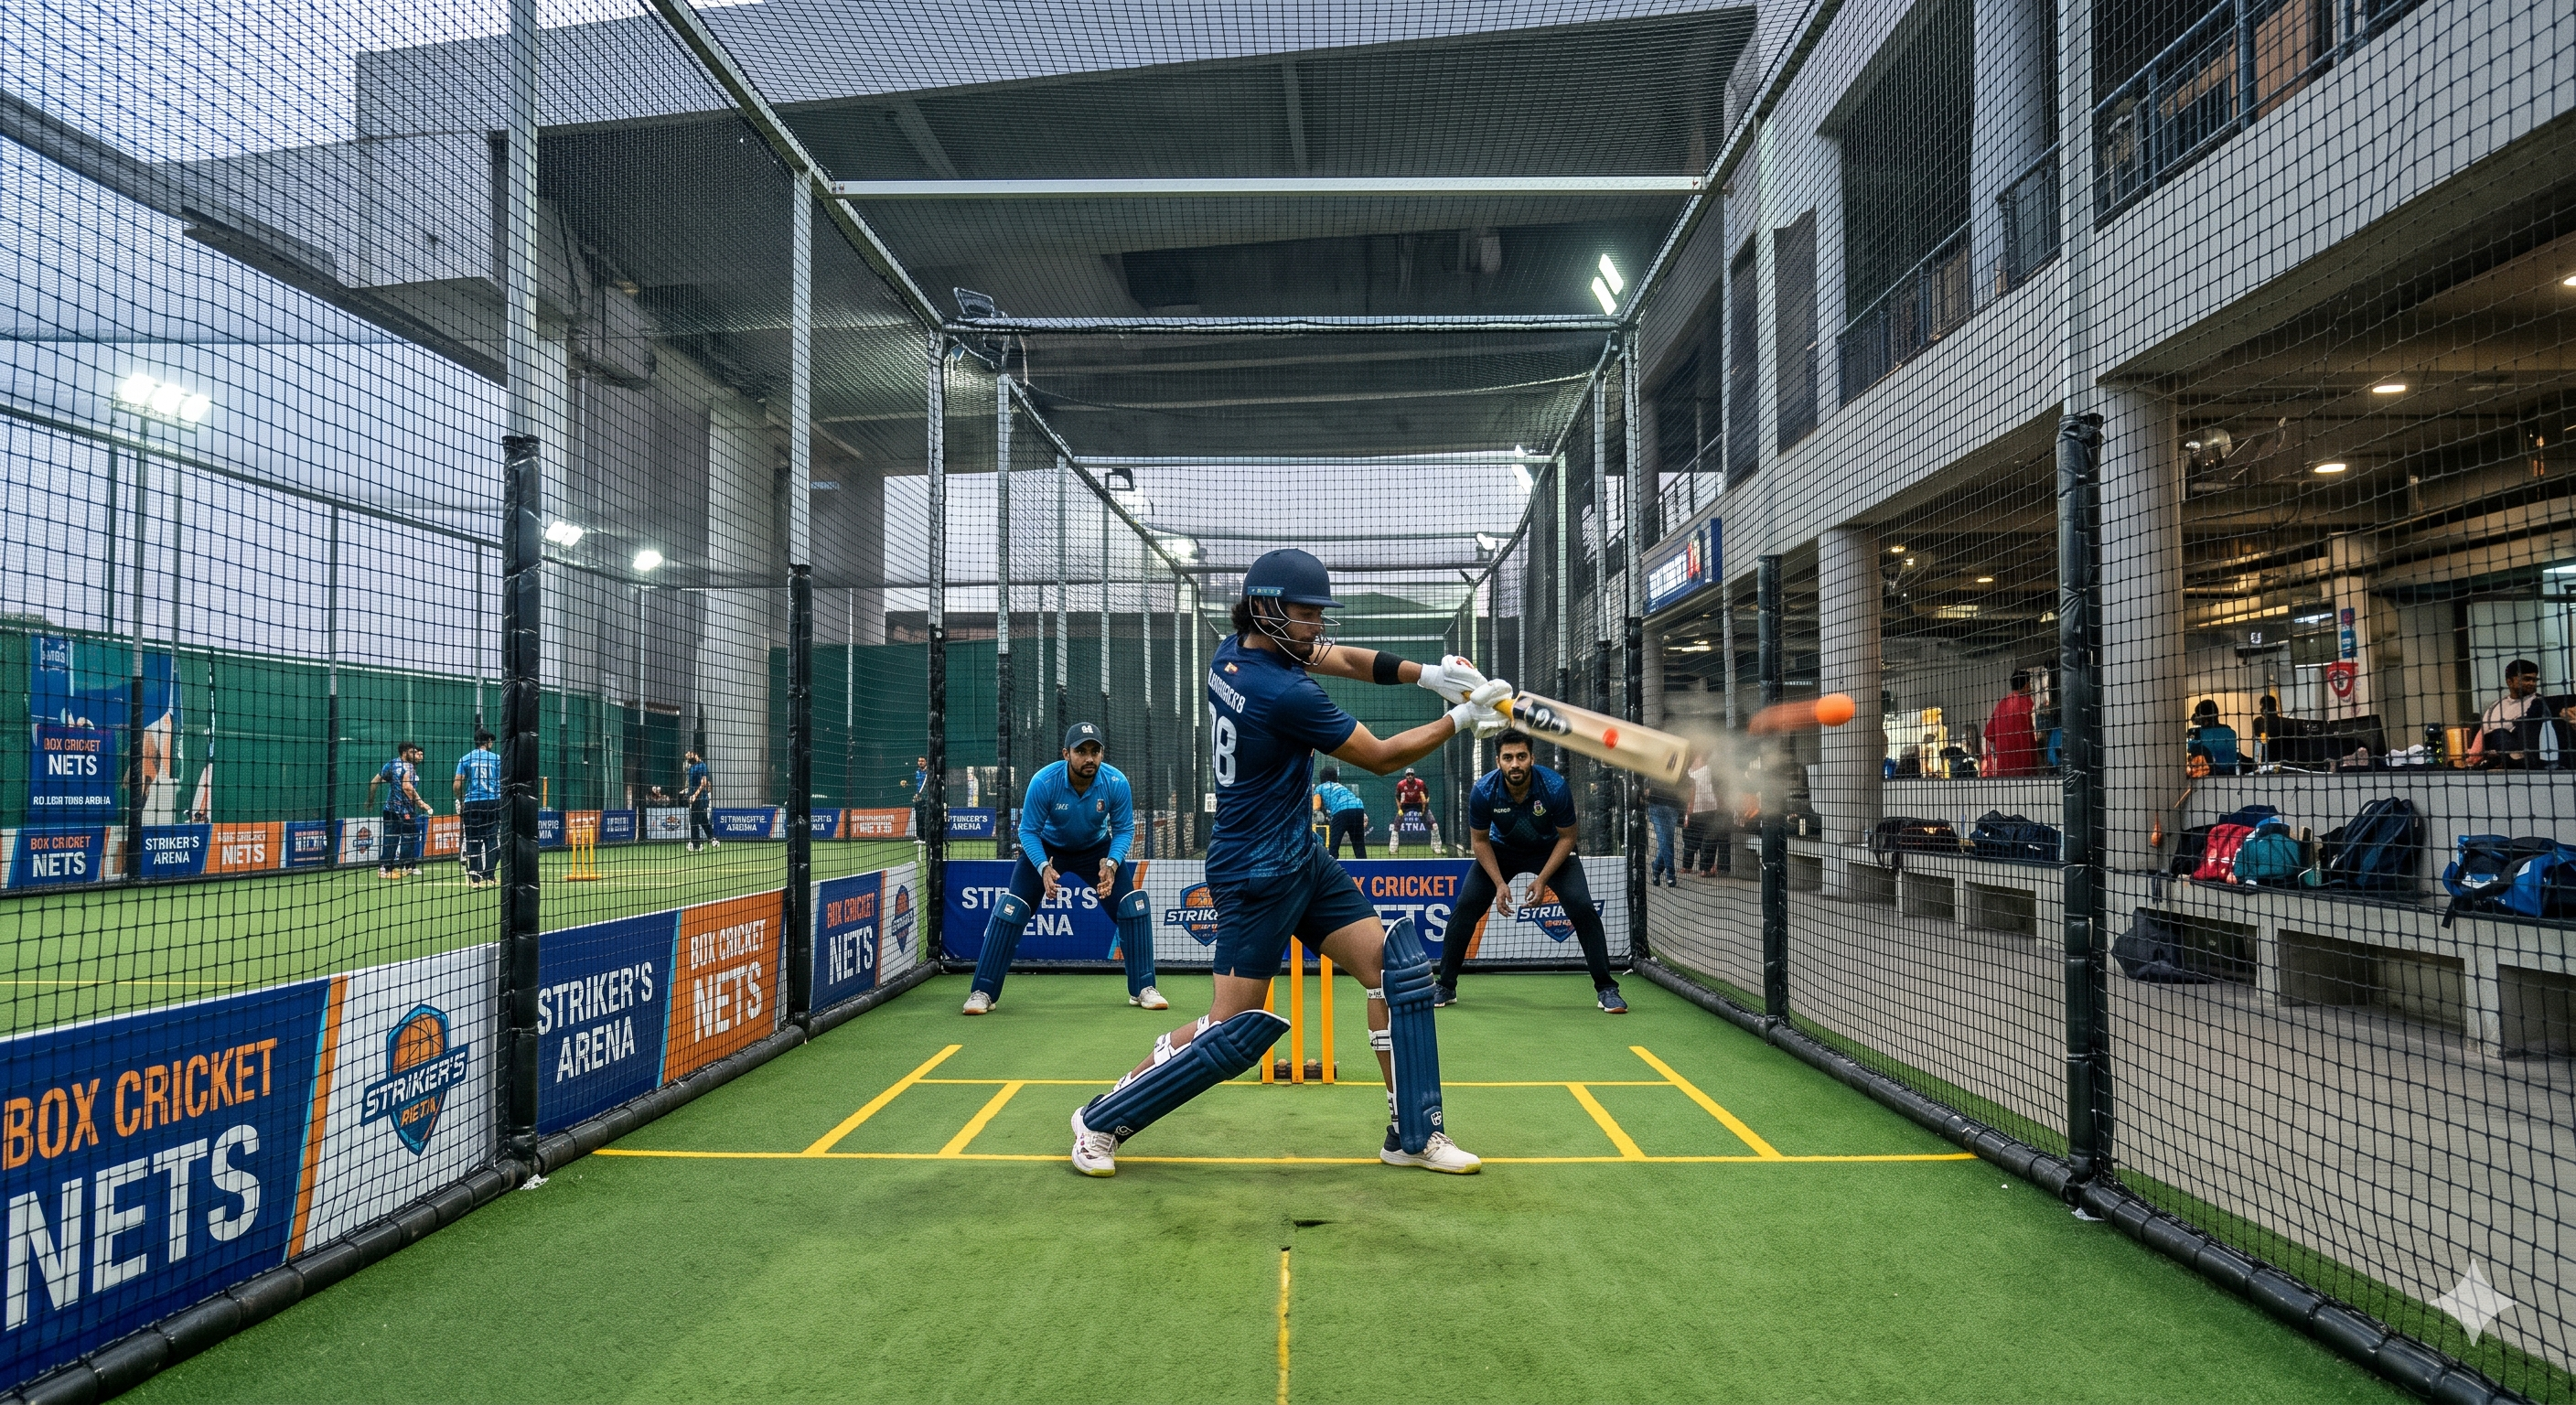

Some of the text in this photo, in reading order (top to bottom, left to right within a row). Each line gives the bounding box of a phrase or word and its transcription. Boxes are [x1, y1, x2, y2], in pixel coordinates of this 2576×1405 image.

[48, 754, 97, 776] NETS
[32, 851, 86, 877] NETS
[145, 836, 199, 851] STRIKER'S
[153, 851, 189, 864] ARENA
[221, 843, 265, 865] NETS
[1371, 875, 1457, 897] CRICKET
[691, 919, 767, 971] BOX CRICKET
[983, 914, 1074, 937] ENA
[1373, 903, 1451, 942] ETS
[829, 926, 874, 985] NETS
[536, 961, 653, 1035] STRIKER'S
[694, 961, 762, 1044] NETS
[556, 1015, 635, 1084] ARENA
[2, 1037, 278, 1171] BOX CRICKET
[364, 1052, 466, 1119] STRIKER'S
[5, 1124, 261, 1332] NETS
